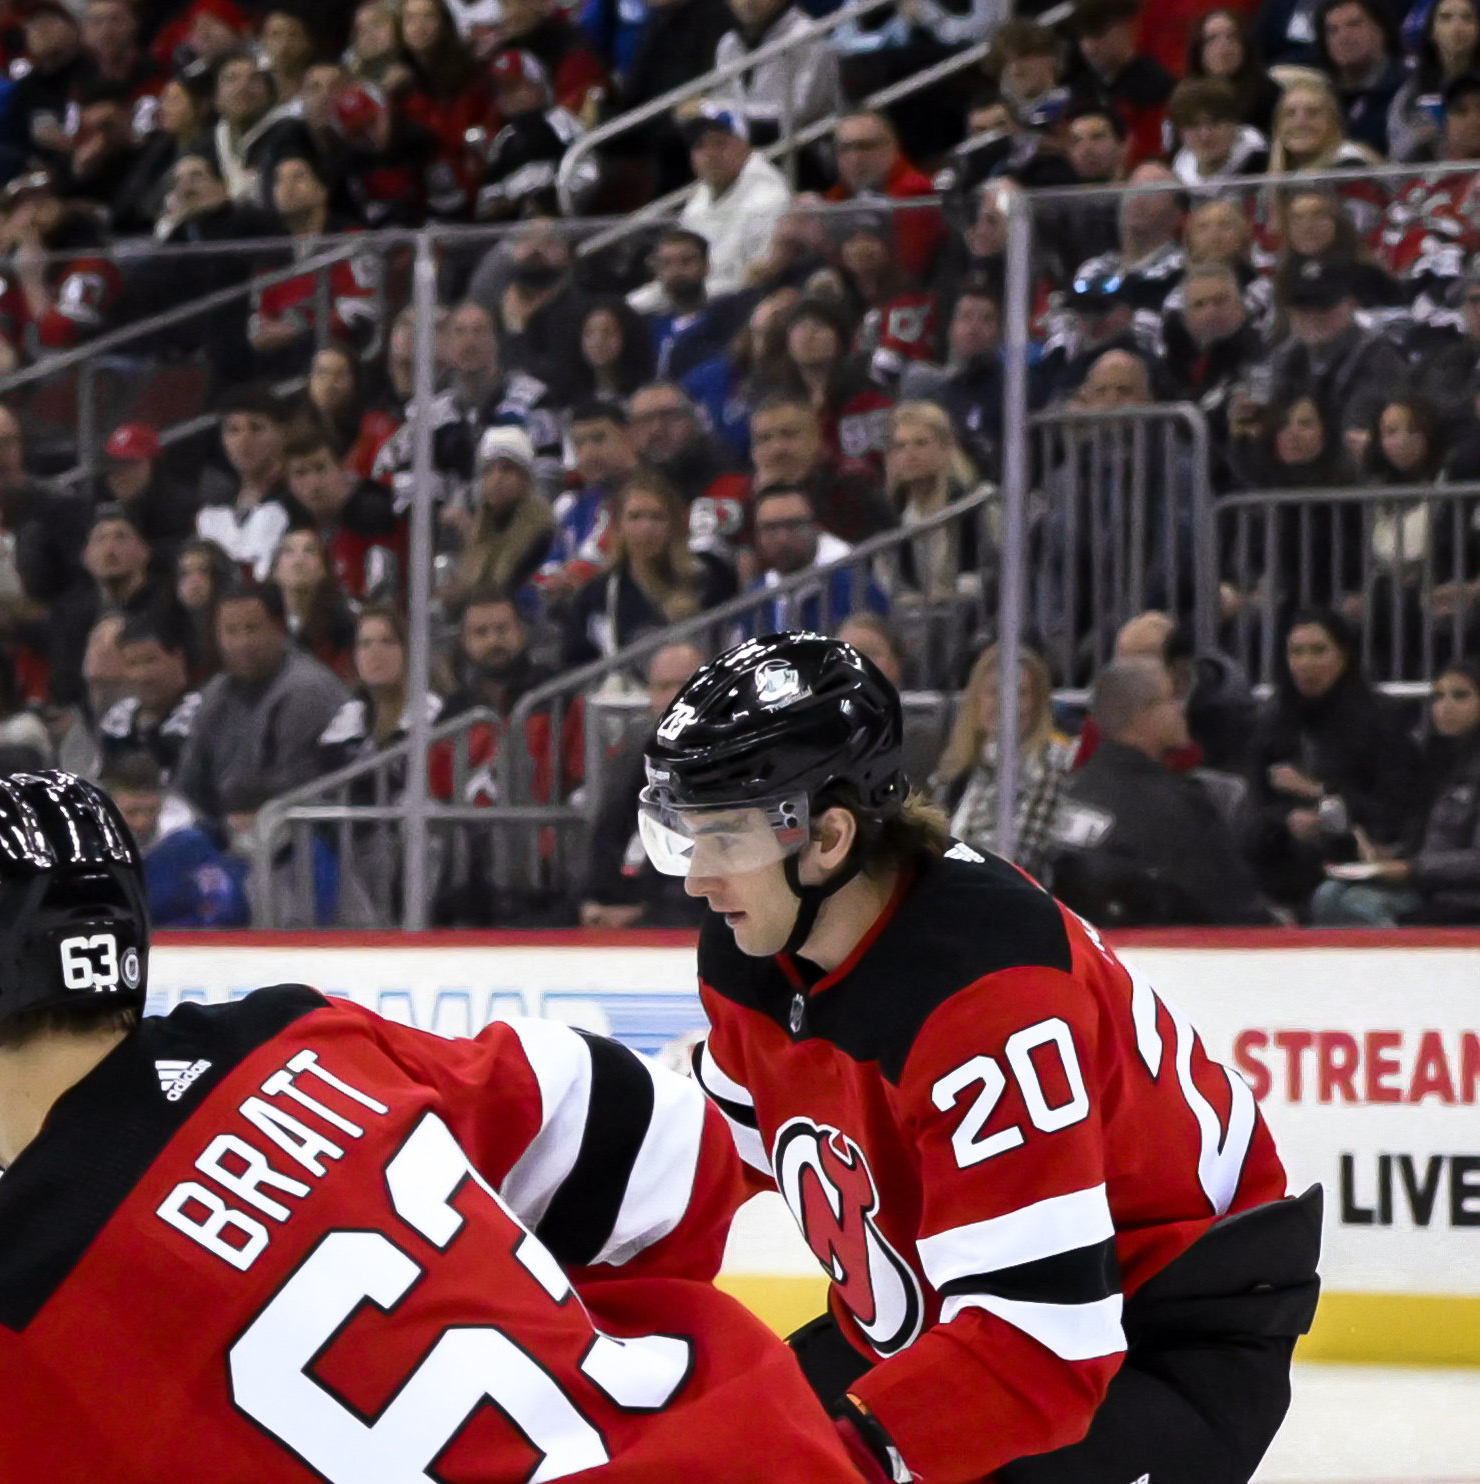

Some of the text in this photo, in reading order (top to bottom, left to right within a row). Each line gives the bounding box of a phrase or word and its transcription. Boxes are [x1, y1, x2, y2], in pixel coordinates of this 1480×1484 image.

[60, 934, 120, 990] 63
[166, 1057, 212, 1102] adidas
[931, 1016, 1090, 1170] 20
[155, 1048, 389, 1272] BRATT
[1341, 1153, 1480, 1226] LIVE
